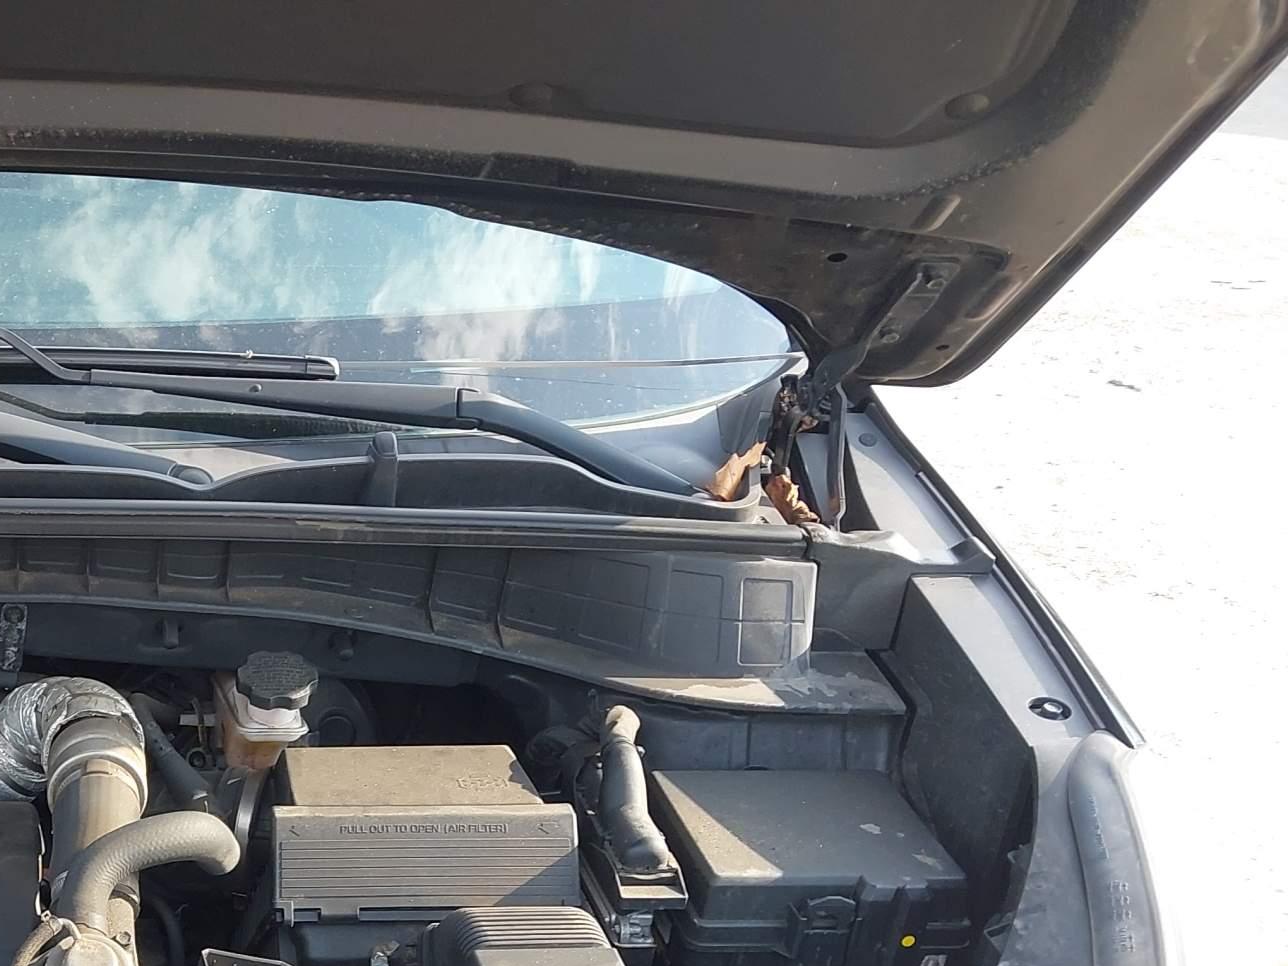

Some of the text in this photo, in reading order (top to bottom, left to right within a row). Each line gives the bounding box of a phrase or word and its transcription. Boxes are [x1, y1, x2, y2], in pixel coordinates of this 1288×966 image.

[339, 822, 508, 835] PULL OUT TO OPEN (AIR FILTER)
